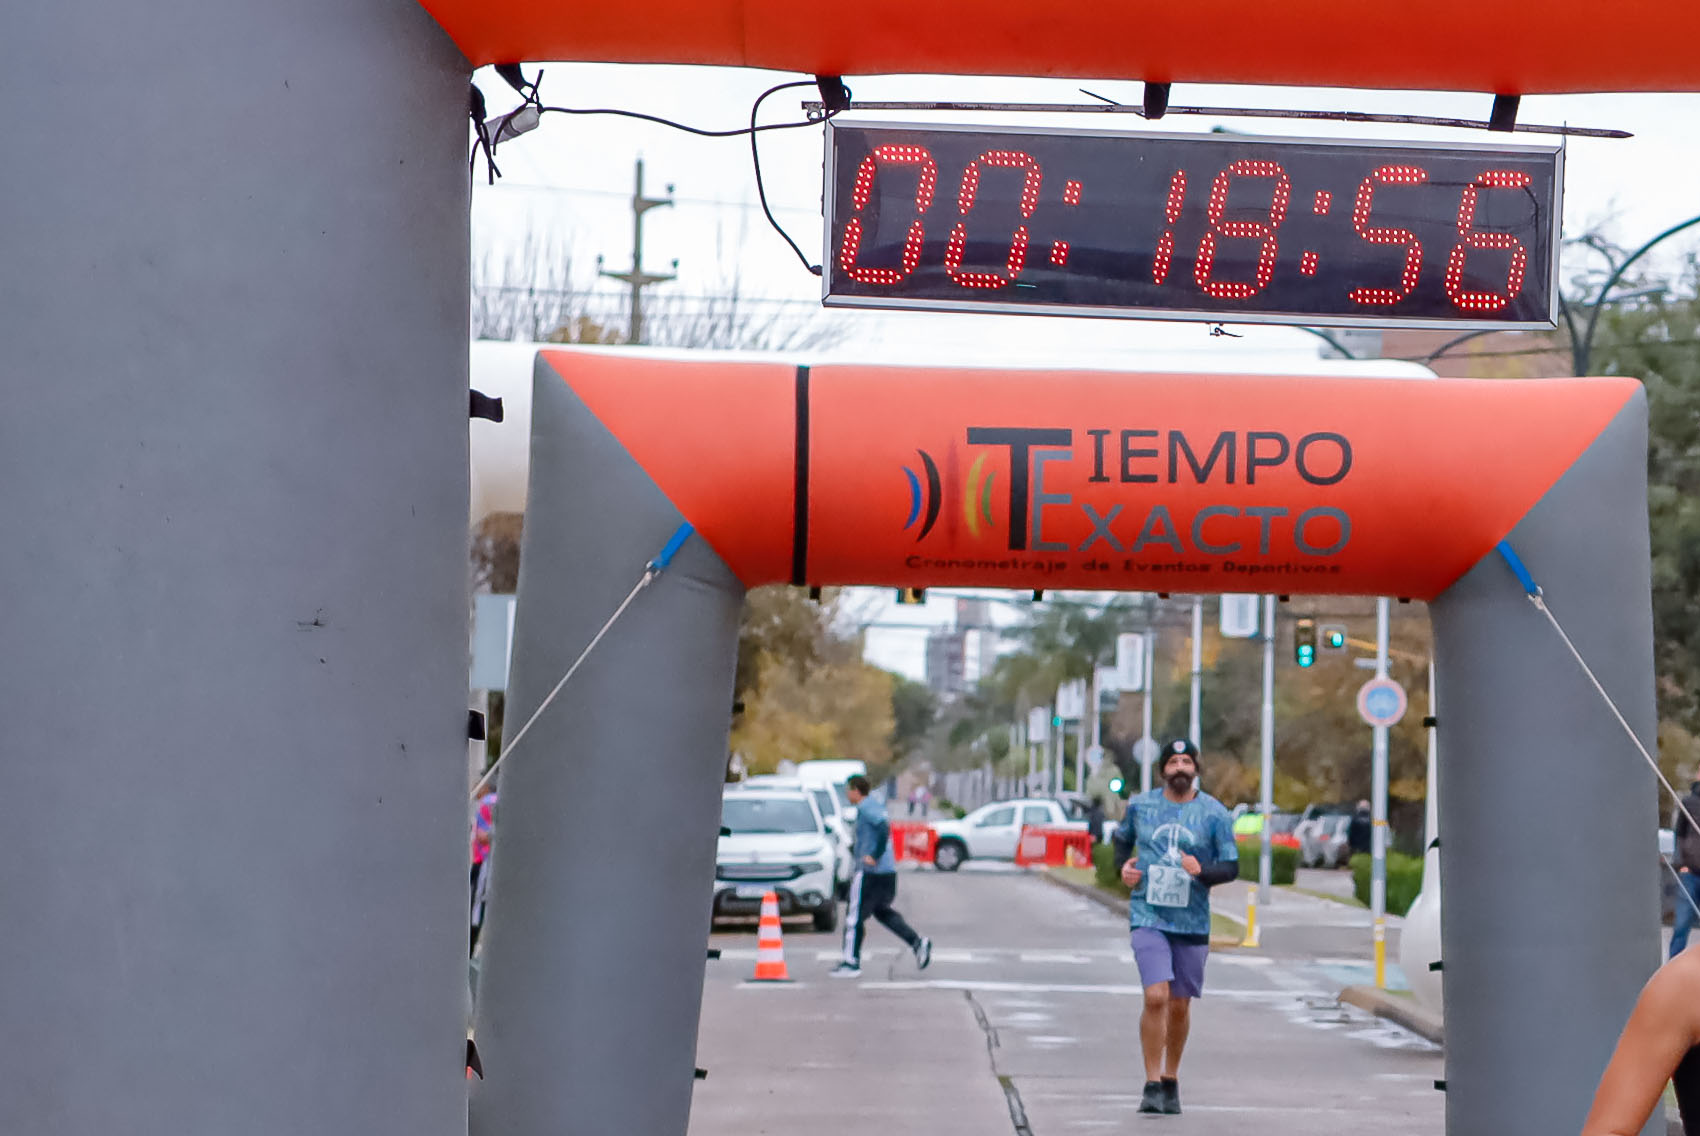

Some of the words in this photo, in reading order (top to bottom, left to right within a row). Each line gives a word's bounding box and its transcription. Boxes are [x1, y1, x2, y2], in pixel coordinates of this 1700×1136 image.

[904, 556, 1068, 572] Cronometraje
[1081, 559, 1111, 572] de
[1123, 560, 1212, 573] Eventos
[1222, 561, 1342, 574] Deportivos
